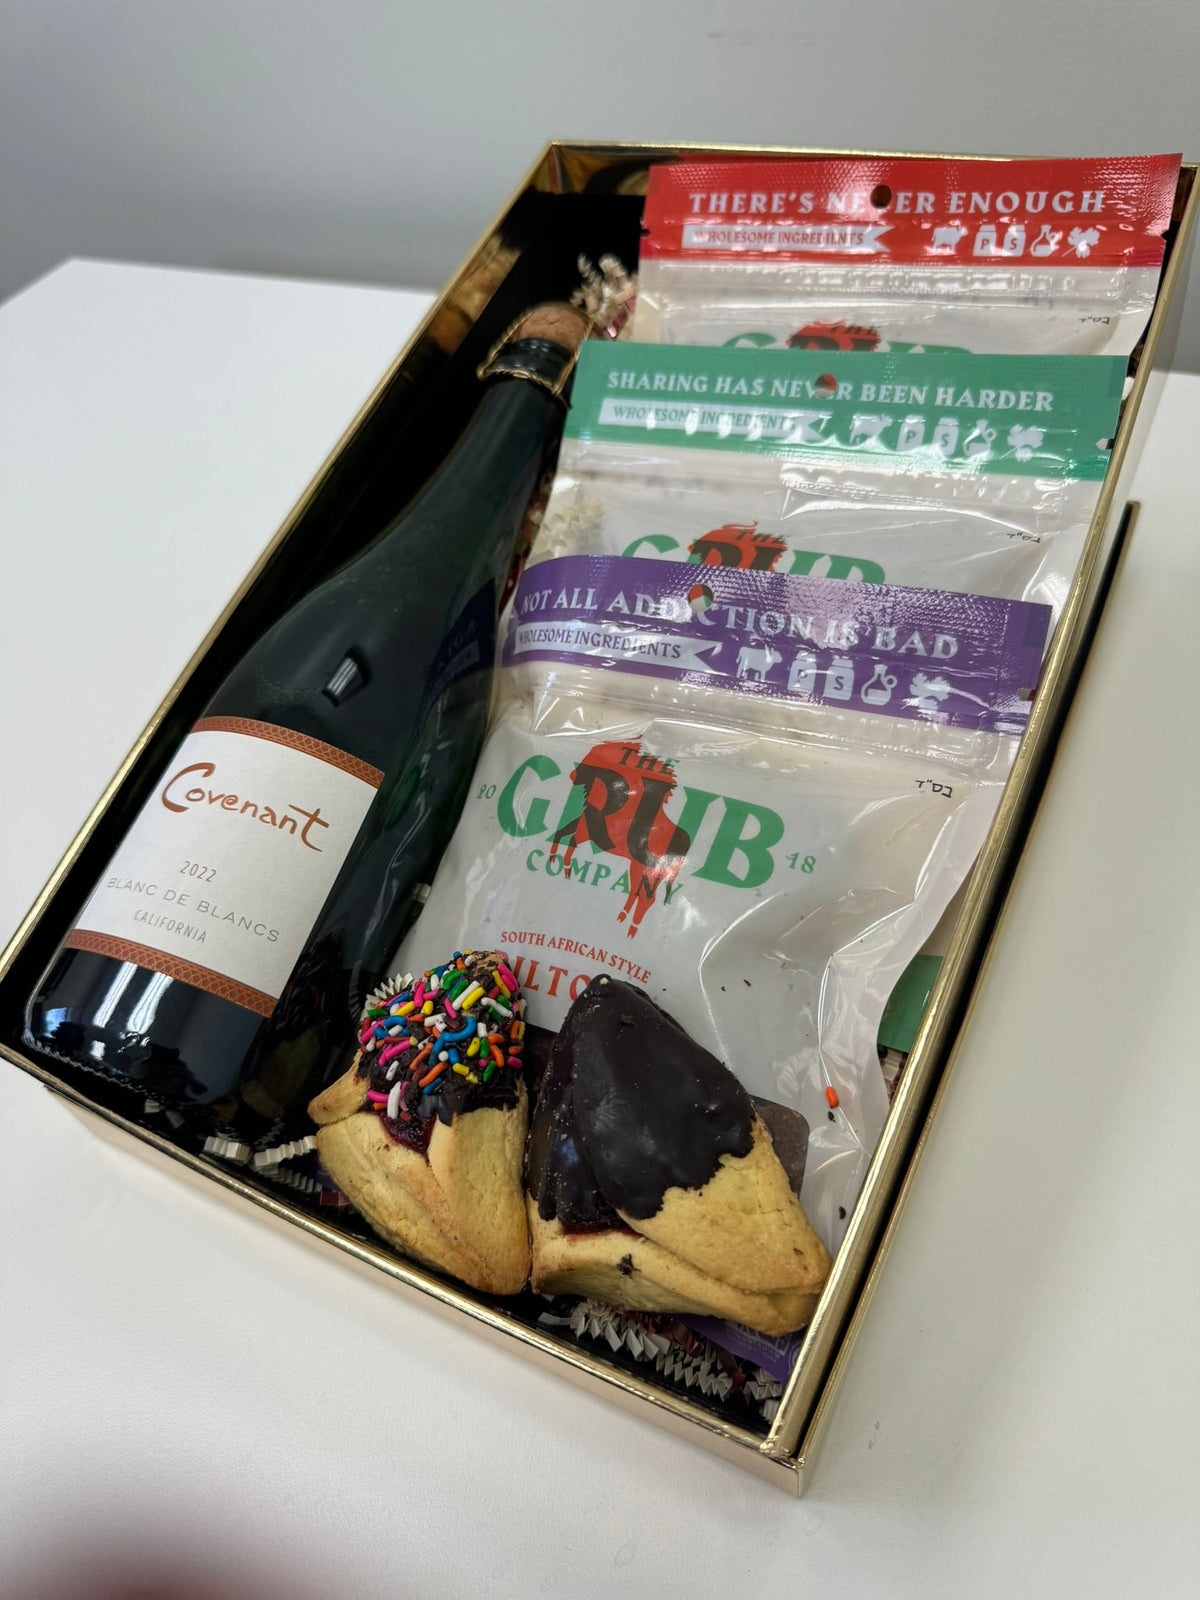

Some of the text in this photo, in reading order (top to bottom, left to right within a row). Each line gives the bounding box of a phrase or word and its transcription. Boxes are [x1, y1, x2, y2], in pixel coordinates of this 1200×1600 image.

[689, 190, 1105, 215] THERE'S NEER ENOUGH
[607, 371, 1054, 412] SHARING HAS NEVR BEEN HARDER
[520, 589, 552, 616] NOT
[553, 587, 599, 611] ALL
[823, 618, 861, 650] IS
[871, 625, 959, 660] BAD
[574, 629, 682, 660] INGREDIENTS
[834, 675, 846, 691] S
[618, 746, 681, 776] THE
[160, 762, 331, 853] Covenant
[496, 754, 786, 890] GRUB
[179, 860, 218, 884] 2022
[525, 849, 684, 905] COMPANY
[787, 850, 817, 875] 18
[106, 876, 281, 944] BLANC DE BLANCS
[133, 908, 208, 946] CALIFORNIA
[500, 930, 652, 985] SOUTH AFRICAN STYLE
